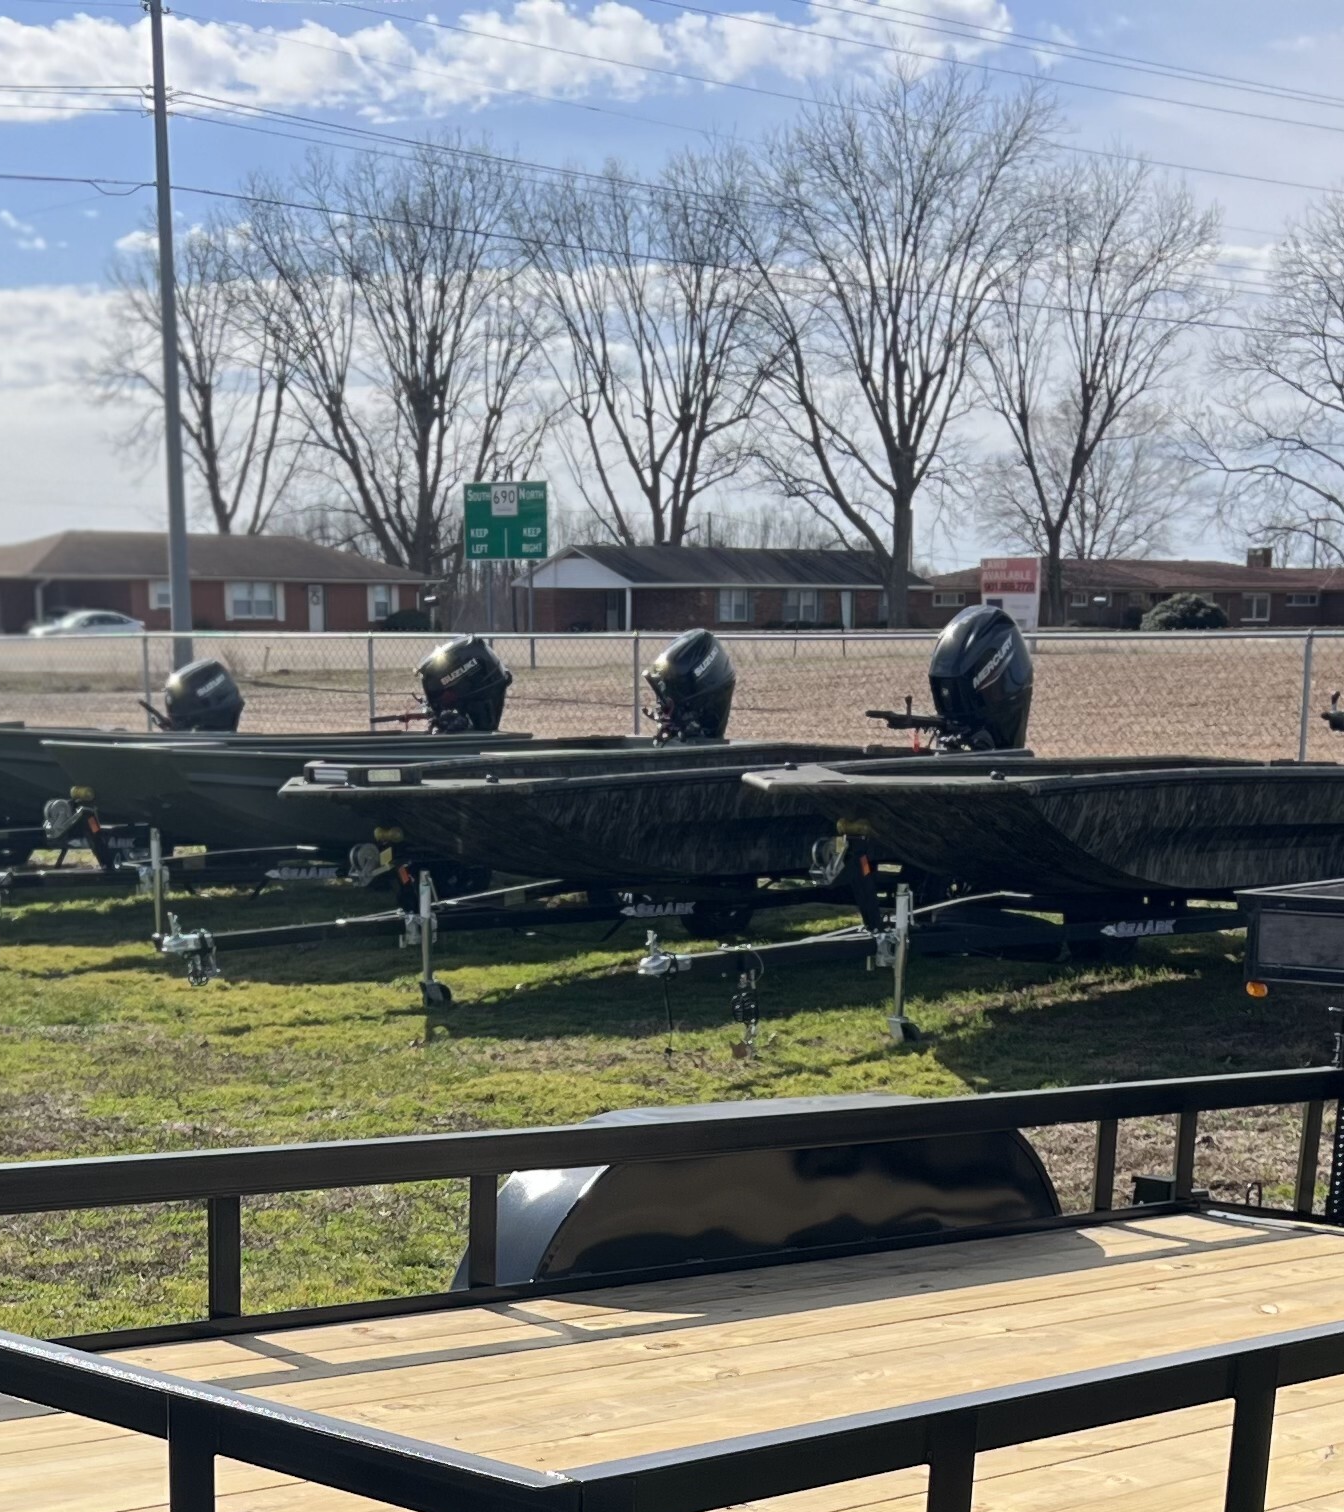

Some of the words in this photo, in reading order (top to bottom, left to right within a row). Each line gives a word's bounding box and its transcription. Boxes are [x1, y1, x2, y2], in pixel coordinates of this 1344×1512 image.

[467, 489, 492, 502] SOUTH
[493, 490, 515, 504] 690
[519, 488, 544, 500] NORTH
[470, 528, 489, 538] KEEP
[522, 527, 542, 537] KEEP
[471, 544, 488, 554] LEFT
[521, 543, 542, 553] RIGHT
[982, 570, 1032, 581] AVAILABLE
[694, 646, 719, 677] SUZUKI
[973, 632, 1012, 689] MERCURY
[440, 657, 478, 686] SUZUKI
